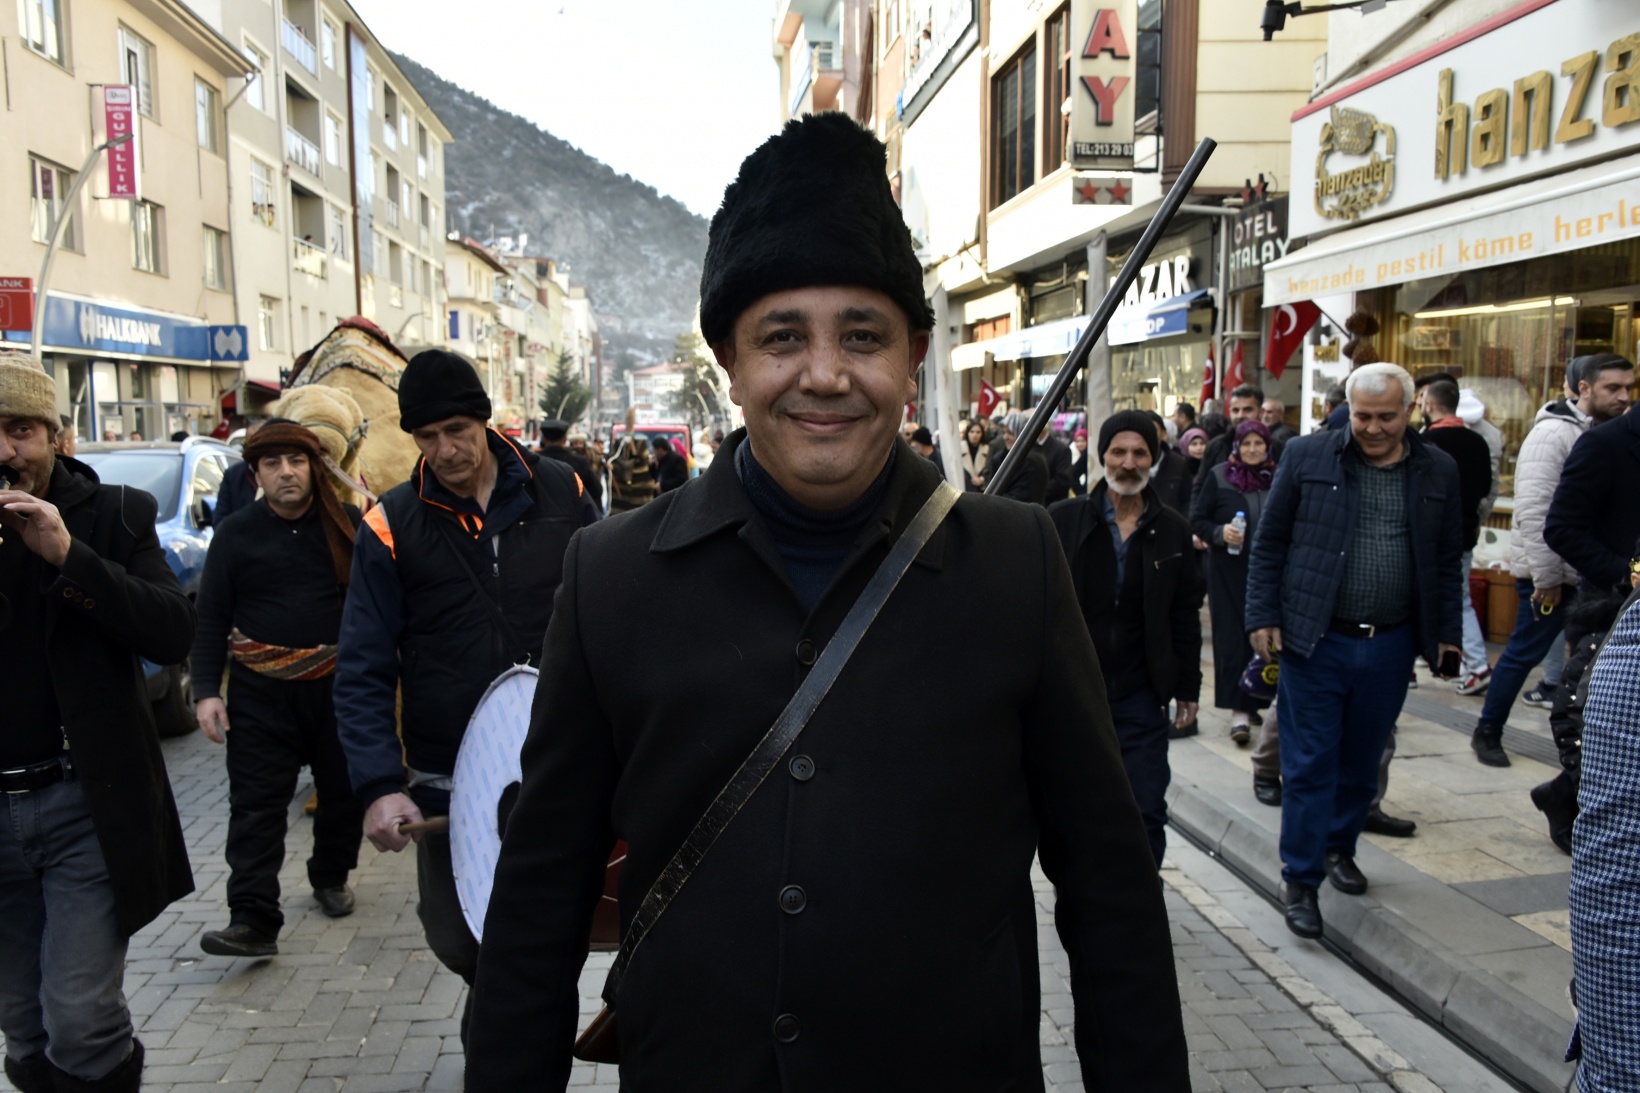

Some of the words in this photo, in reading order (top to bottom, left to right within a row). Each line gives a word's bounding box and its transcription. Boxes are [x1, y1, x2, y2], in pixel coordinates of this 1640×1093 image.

[1079, 8, 1131, 127] AY
[1111, 144, 1122, 155] 29
[1123, 144, 1134, 156] 03
[1234, 211, 1278, 246] OTEL
[1229, 236, 1291, 272] ATALAY
[1377, 243, 1444, 283] pestil
[1458, 231, 1533, 264] köme
[97, 315, 162, 346] HALKBANK
